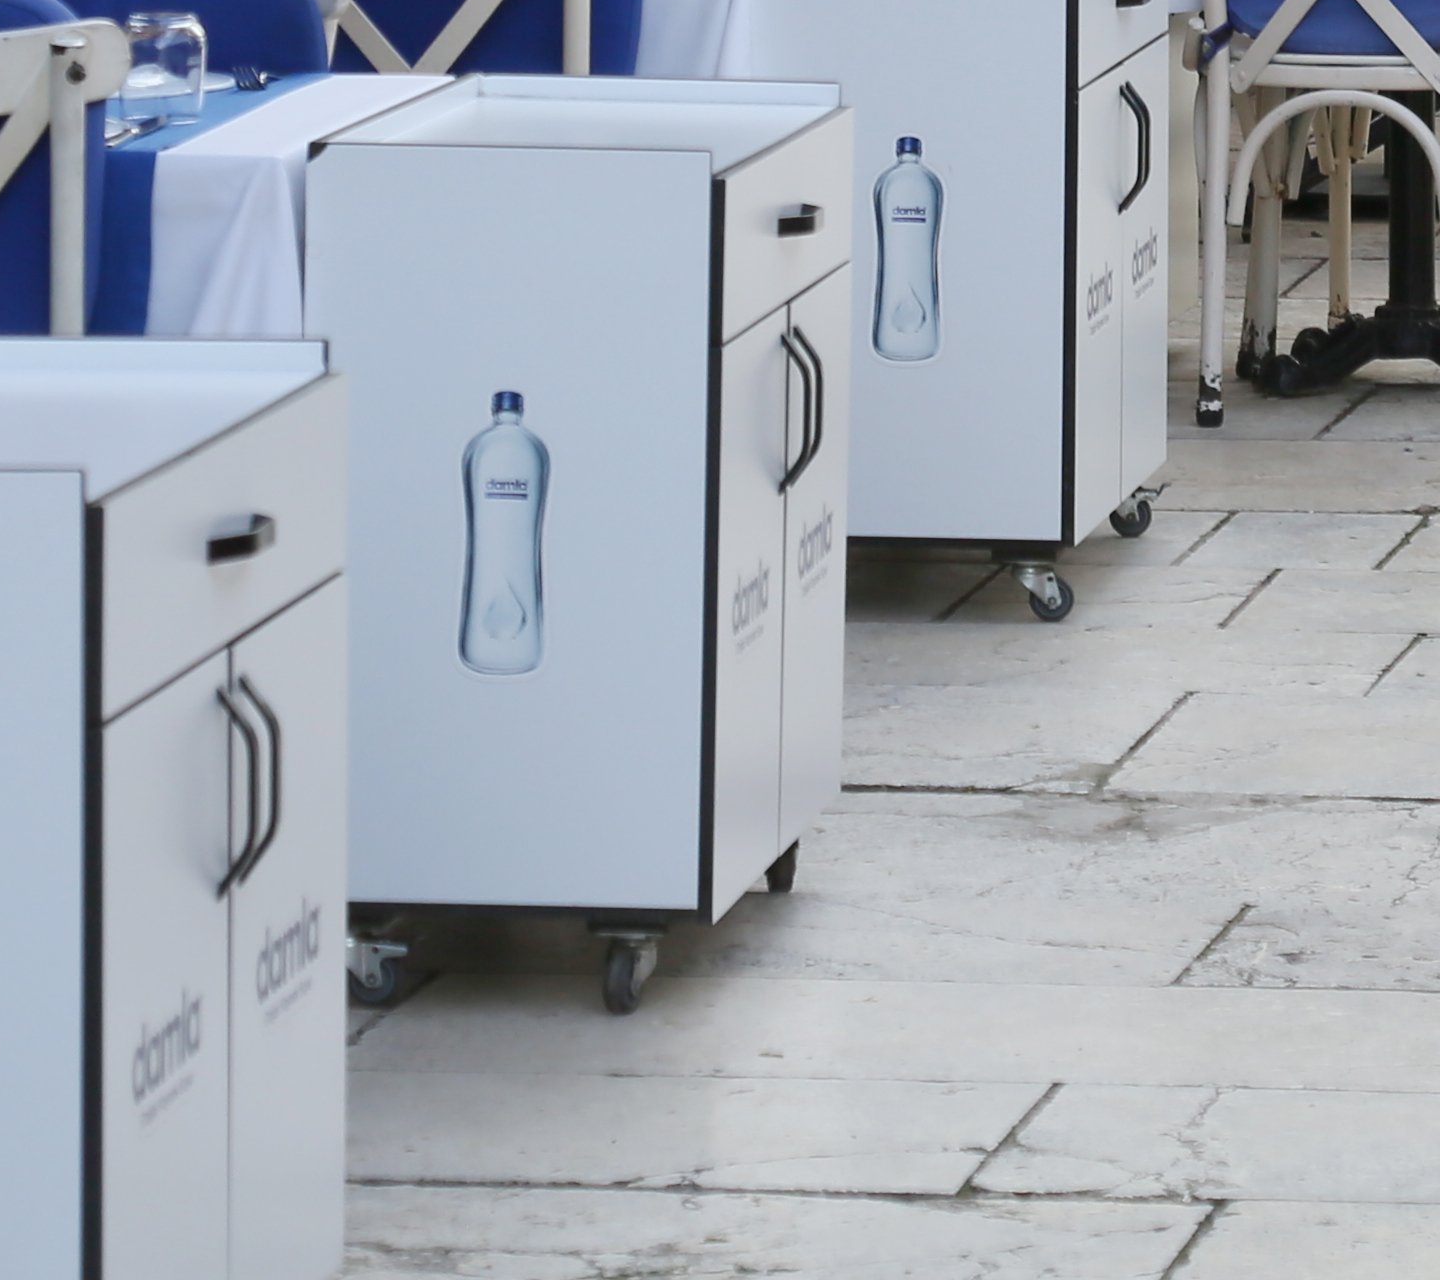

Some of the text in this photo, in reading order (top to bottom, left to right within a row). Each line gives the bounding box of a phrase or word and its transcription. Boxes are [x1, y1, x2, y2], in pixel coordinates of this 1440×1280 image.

[1086, 260, 1113, 321] damla
[1131, 226, 1158, 286] damla
[485, 478, 528, 491] damla
[797, 502, 834, 579] damla
[731, 558, 770, 636] damla
[256, 894, 323, 1006] damla
[131, 987, 203, 1106] damla
